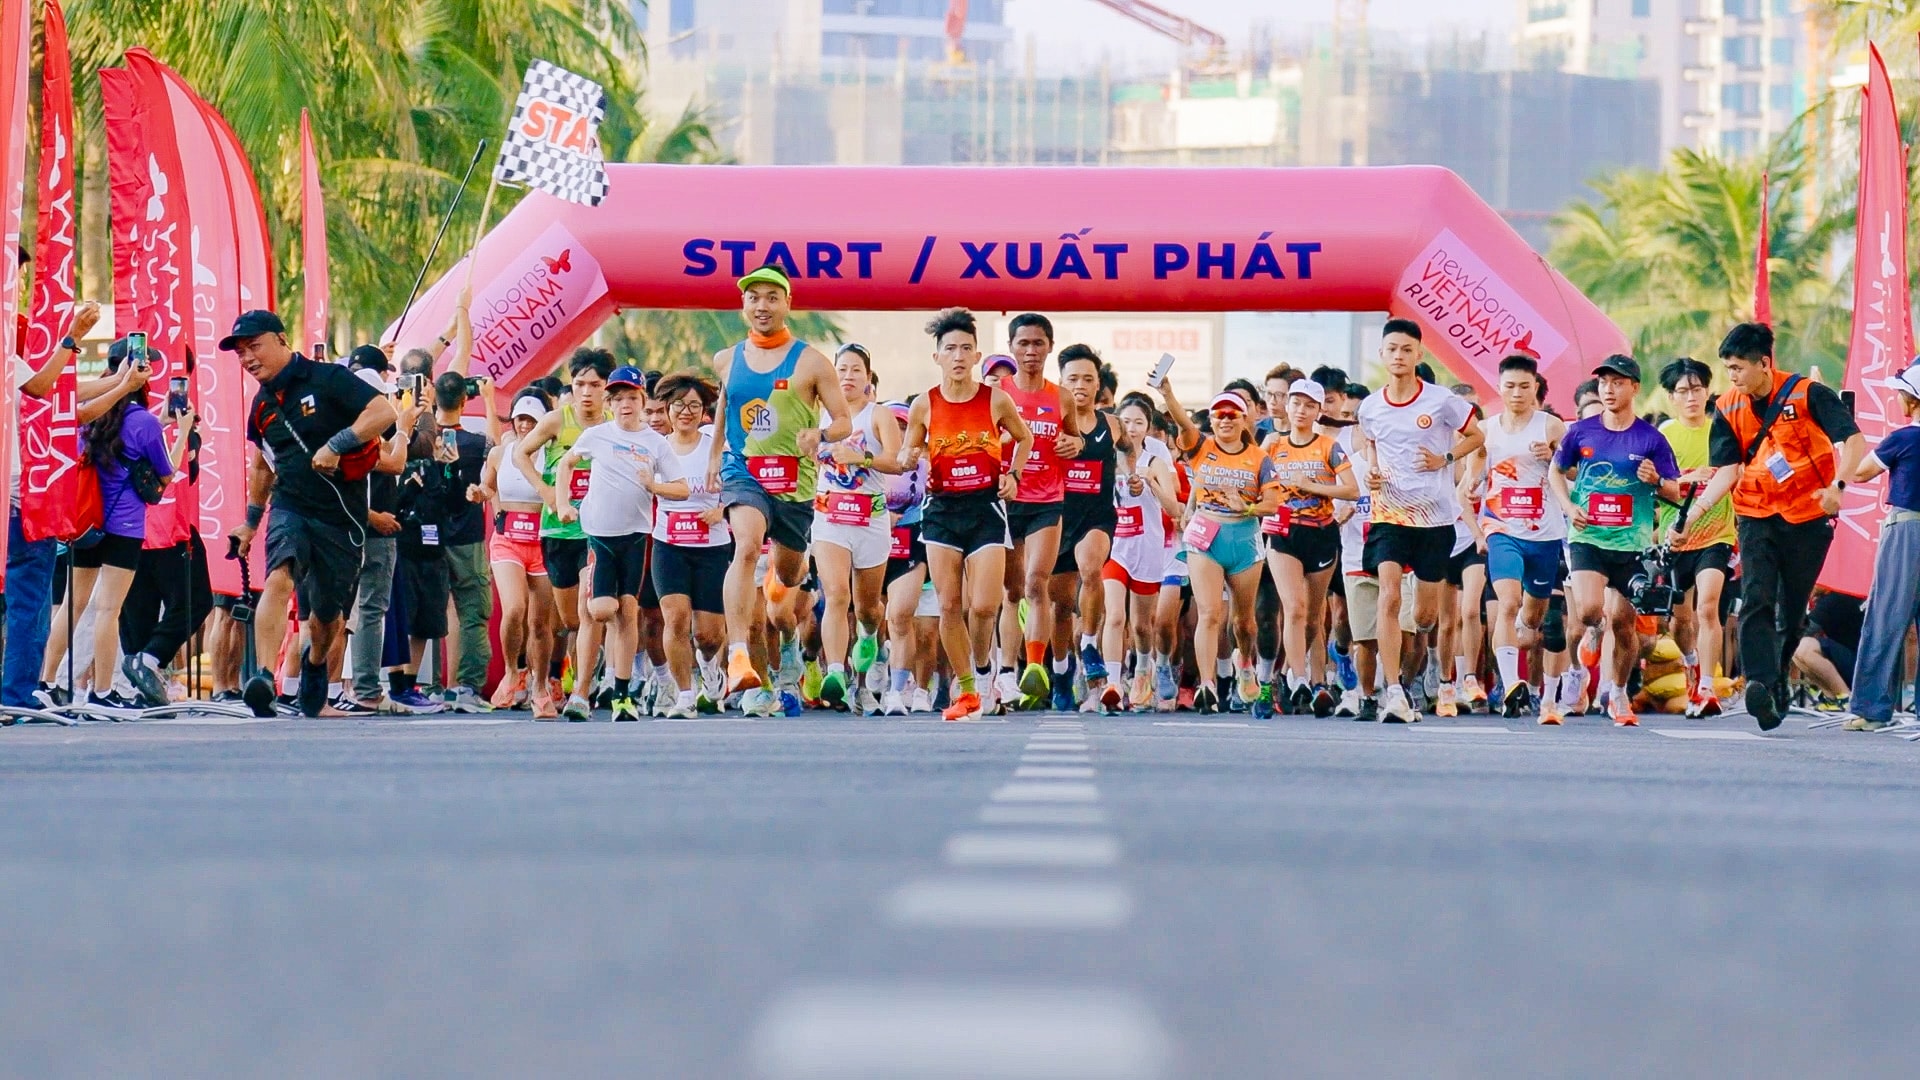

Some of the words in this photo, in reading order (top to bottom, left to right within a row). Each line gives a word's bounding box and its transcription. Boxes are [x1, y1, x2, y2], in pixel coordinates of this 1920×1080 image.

[521, 100, 593, 155] STA
[683, 238, 883, 279] START
[908, 235, 938, 284] /
[958, 227, 1129, 280] XUẤT
[1153, 231, 1322, 280] PHÁT
[1431, 248, 1525, 338] newborns
[470, 277, 564, 364] VIETNAM
[472, 263, 547, 342] ewborns
[487, 337, 528, 382] RUN
[530, 298, 566, 341] OUT
[1404, 282, 1450, 322] RUN
[1448, 323, 1491, 358] OUT
[1422, 261, 1512, 354] VIETNAM
[1067, 469, 1092, 479] 0707
[675, 521, 698, 531] 0141
